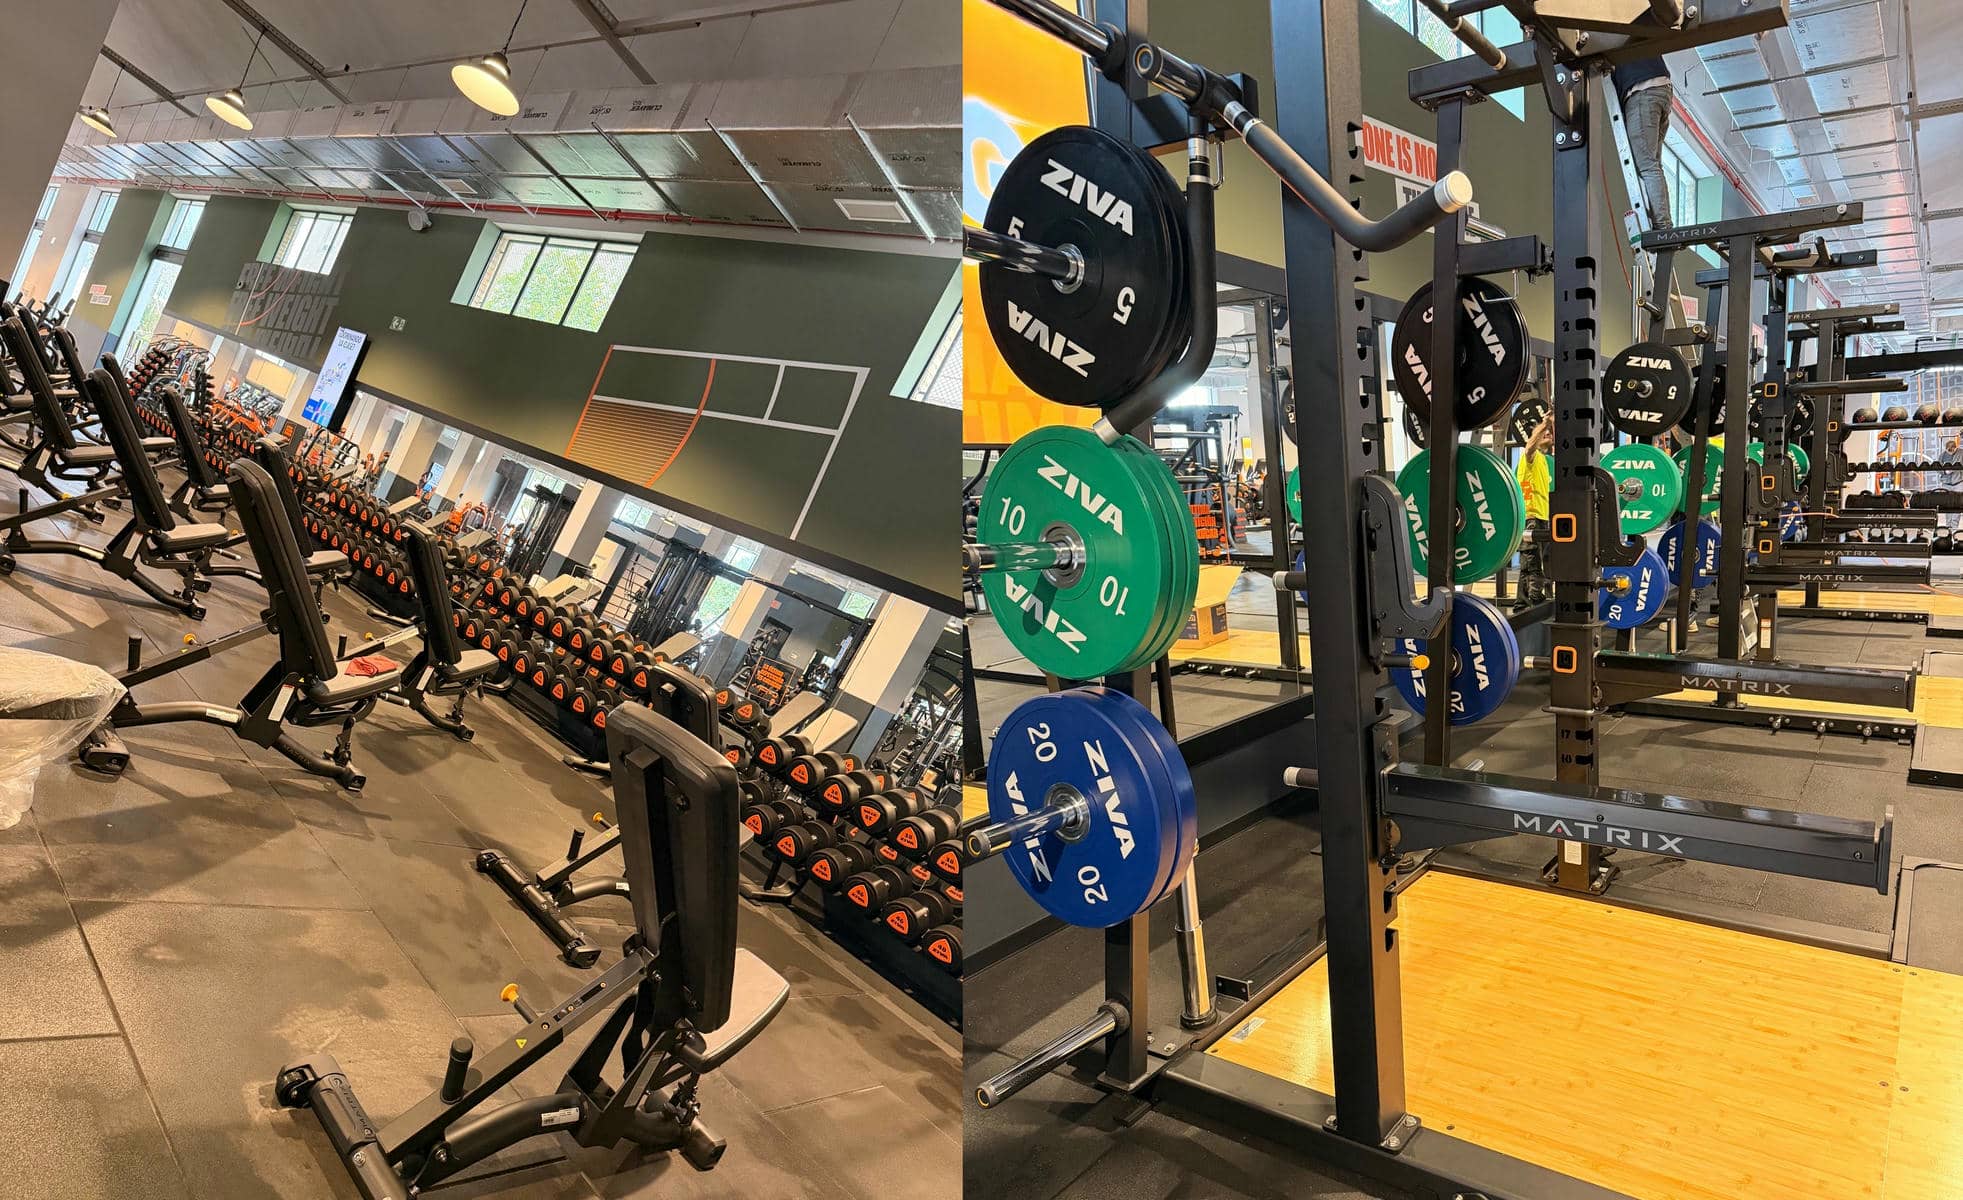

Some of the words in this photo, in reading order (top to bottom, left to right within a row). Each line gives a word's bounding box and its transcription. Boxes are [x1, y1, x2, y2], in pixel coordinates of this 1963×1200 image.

[1362, 120, 1396, 169] ONE
[1395, 134, 1413, 174] IS
[1413, 141, 1437, 182] MO
[1040, 158, 1134, 236] ZIVA
[1007, 216, 1024, 240] 5
[1656, 225, 1720, 242] MATRIX
[1112, 286, 1136, 325] 5
[1007, 300, 1096, 378] ZIVA
[1462, 292, 1506, 367] ZIVA
[1404, 343, 1433, 403] IVA
[1625, 355, 1672, 371] ZIVA
[1467, 386, 1486, 405] 5
[1612, 379, 1623, 394] 5
[1667, 385, 1678, 400] 5
[1618, 408, 1664, 424] ZIVA
[1611, 460, 1656, 470] ZIVA
[1037, 454, 1123, 536] ZIVA
[1465, 470, 1497, 541] ZIVA
[1652, 483, 1666, 497] 10
[999, 496, 1026, 536] 10
[1404, 492, 1429, 561] ZIVA
[1620, 510, 1654, 520] ZIV
[1454, 547, 1473, 570] 10
[1667, 536, 1677, 572] ZIVA
[1705, 538, 1716, 570] ZIVA
[1100, 575, 1129, 616] 10
[1635, 567, 1652, 612] ZIVA
[1799, 574, 1865, 582] MATRIX
[1005, 573, 1088, 654] ZIVA
[1608, 604, 1623, 621] 20
[1465, 623, 1490, 692] ZIVA
[1681, 675, 1793, 696] MATRIX
[1027, 722, 1057, 762] 20
[1083, 740, 1136, 860] ZIVA
[1513, 813, 1684, 855] MATRIX
[1077, 865, 1109, 905] 20
